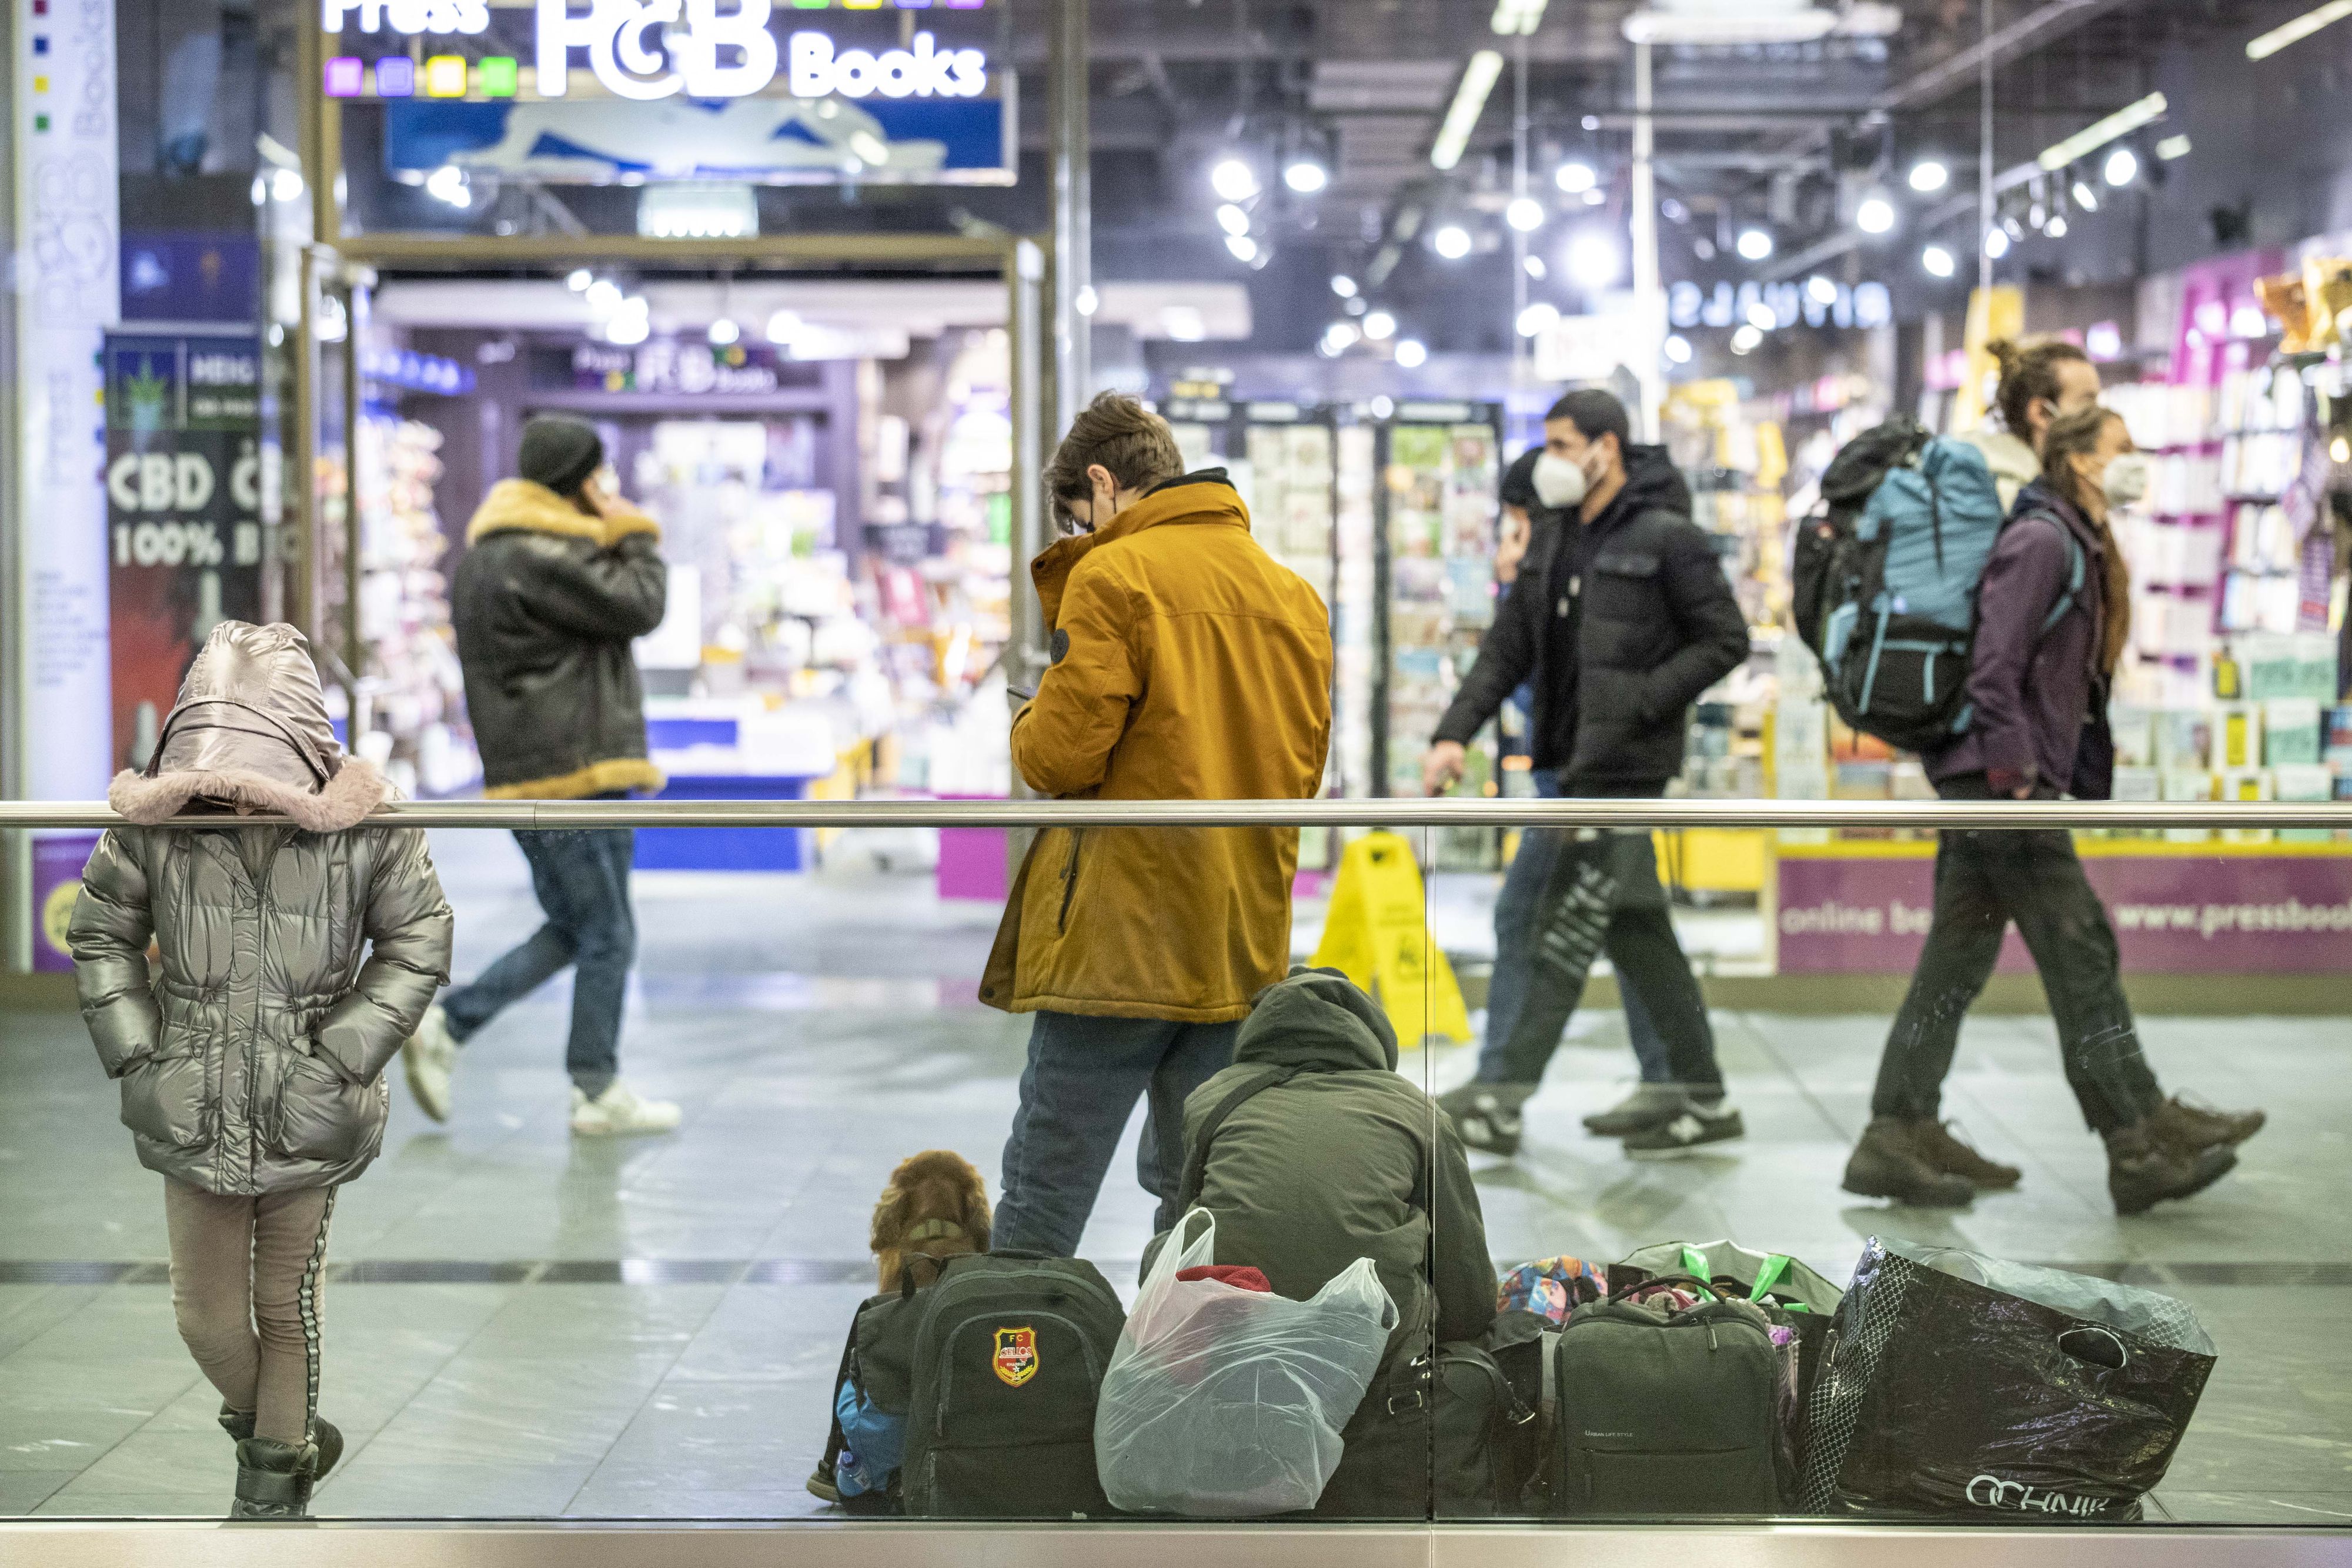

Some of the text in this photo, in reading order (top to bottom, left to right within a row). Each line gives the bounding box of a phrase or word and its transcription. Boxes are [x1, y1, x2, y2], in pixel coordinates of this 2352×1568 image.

[790, 31, 987, 98] Books
[108, 452, 215, 512] CBD
[116, 521, 223, 566] 100%
[2115, 897, 2352, 940] www.pressboo
[1000, 1346, 1033, 1357] GELIOS
